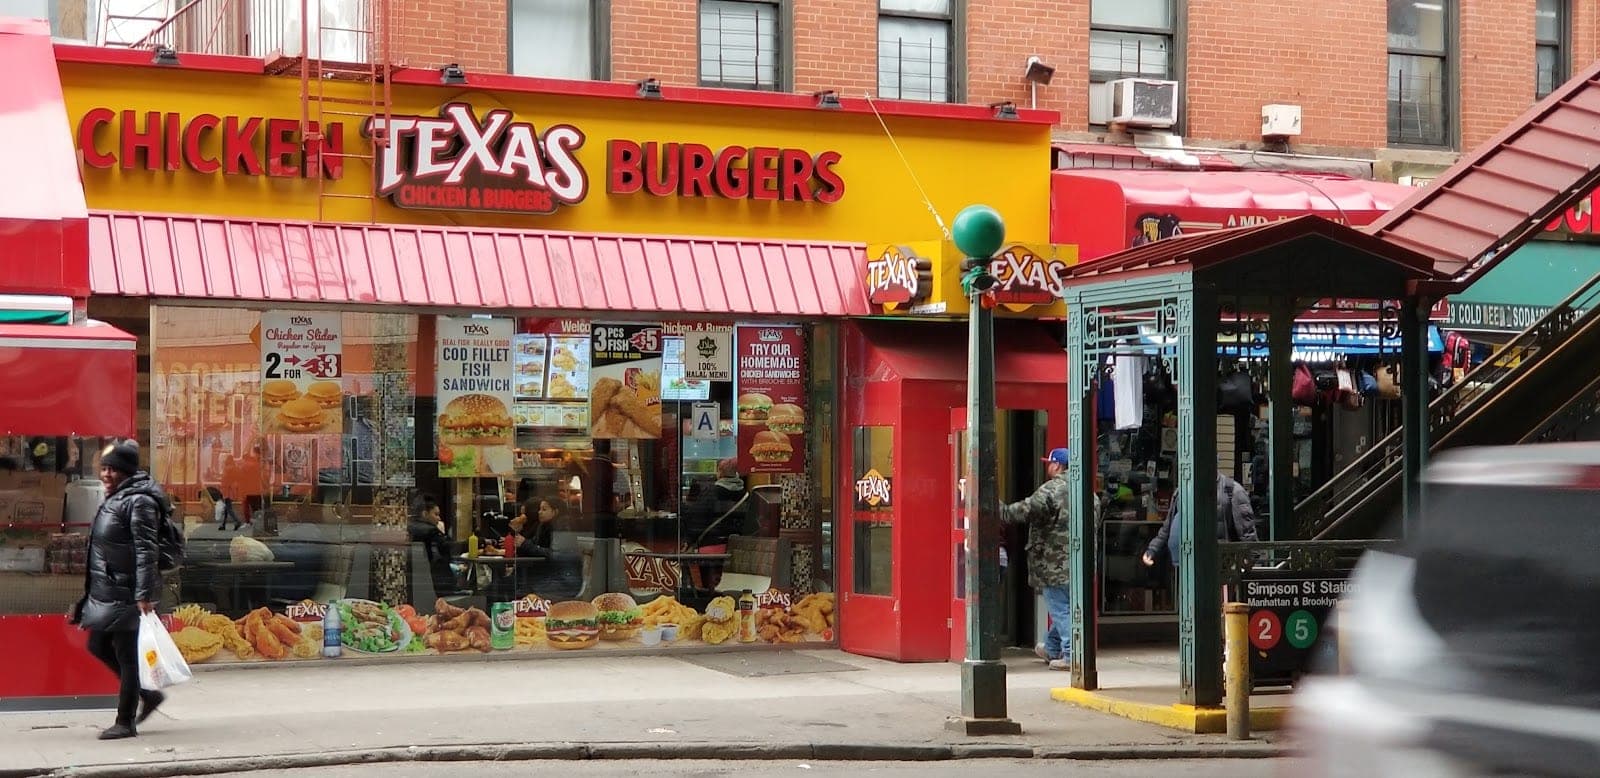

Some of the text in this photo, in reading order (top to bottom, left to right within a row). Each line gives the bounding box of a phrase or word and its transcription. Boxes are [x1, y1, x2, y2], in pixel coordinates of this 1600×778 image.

[78, 107, 343, 180] CHICKEN
[368, 104, 584, 199] TEXAS
[606, 138, 845, 204] BURGERS
[402, 185, 553, 211] CHICKEN & BURGERS
[868, 252, 917, 297] TEXAS
[990, 252, 1067, 298] EXAS
[290, 315, 313, 325] TEXAS
[1458, 304, 1482, 325] COLD
[265, 328, 338, 340] Chicken Slider
[463, 324, 489, 335] TEXAS
[608, 327, 625, 338] PCS
[594, 327, 607, 351] 3
[608, 339, 629, 351] FISH
[640, 330, 657, 351] $5
[443, 347, 509, 362] COD FILLET
[750, 343, 791, 356] TRY OUR
[265, 352, 281, 379] 2
[318, 354, 338, 377] $3
[462, 363, 490, 377] FISH
[698, 362, 717, 371] 100%
[741, 357, 800, 369] HOMEMADE
[284, 369, 301, 379] FOR
[443, 378, 510, 392] SANDWICH
[698, 411, 713, 431] A
[856, 476, 890, 503] TEXAS
[1248, 581, 1360, 597] Simpson St Station
[511, 598, 552, 614] TEXAS
[756, 591, 791, 607] TEXAS
[1248, 597, 1337, 608] Manhattan & Brooklyn
[286, 603, 327, 619] TEXAS
[1259, 618, 1309, 641] 2 5
